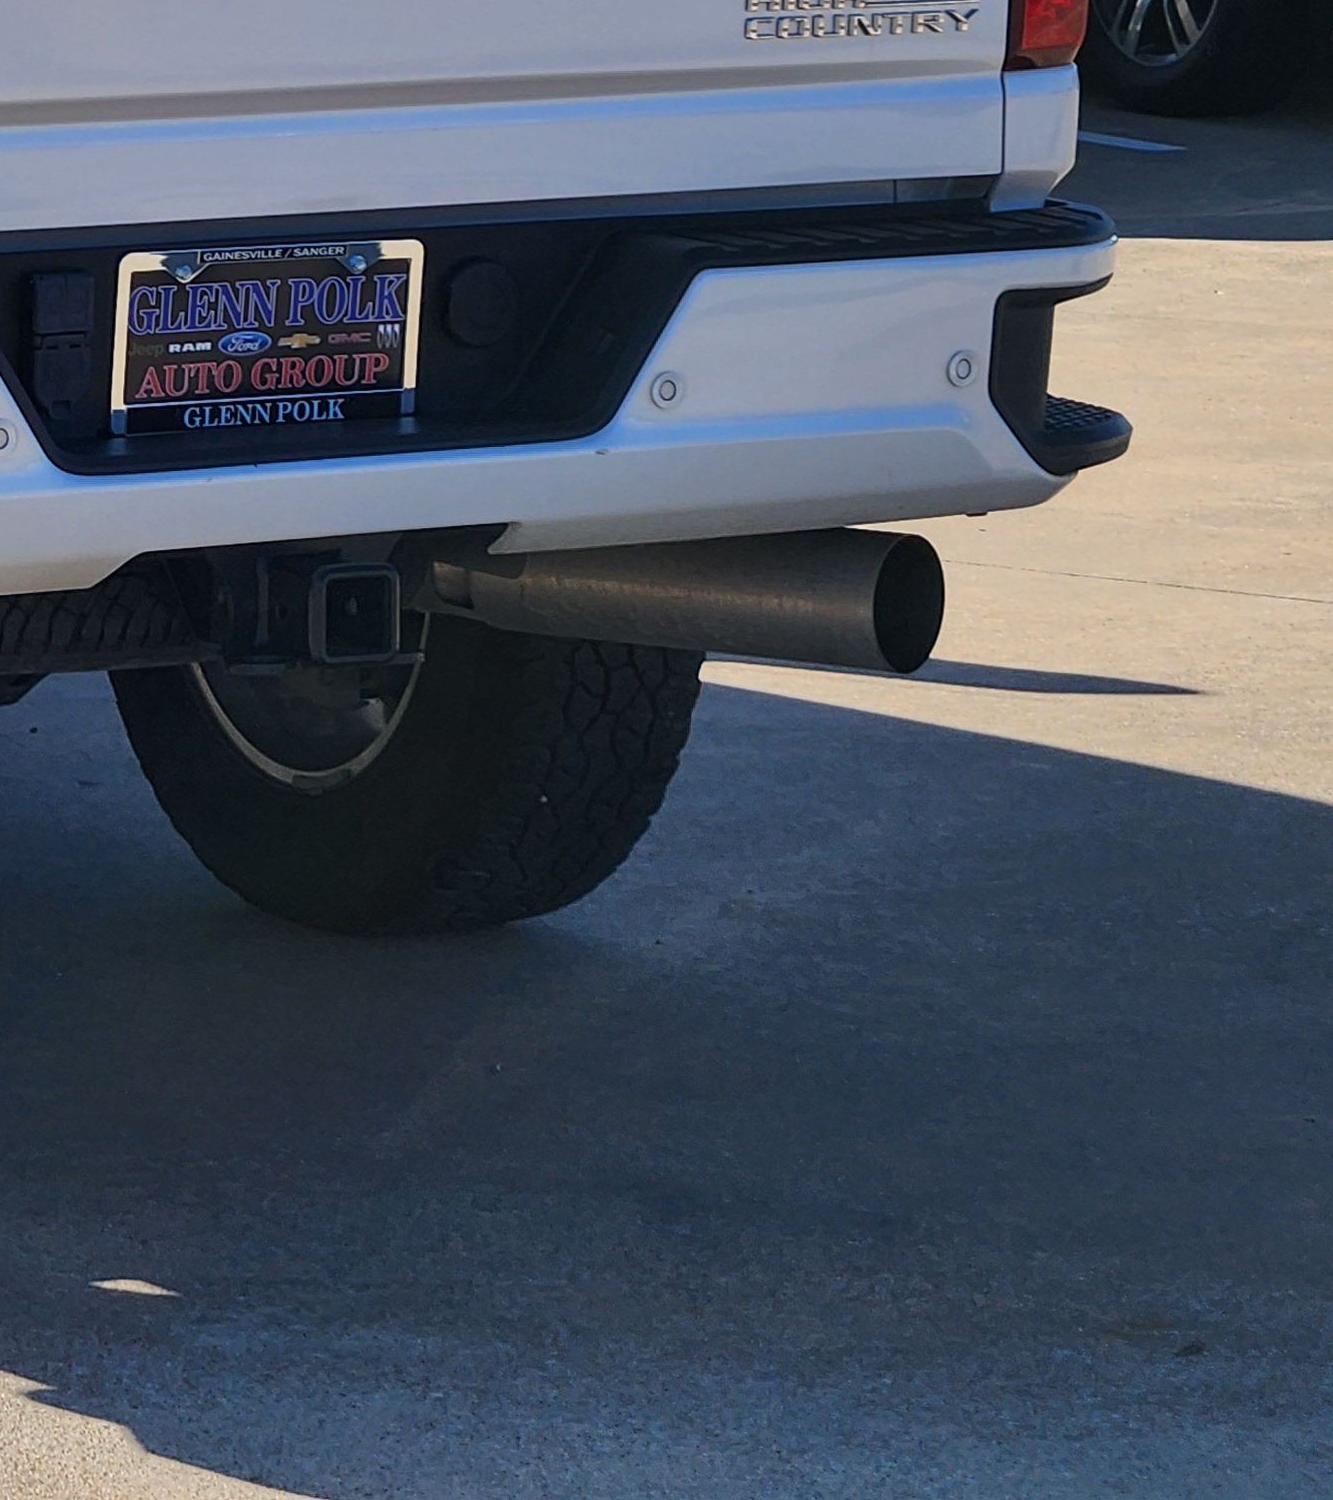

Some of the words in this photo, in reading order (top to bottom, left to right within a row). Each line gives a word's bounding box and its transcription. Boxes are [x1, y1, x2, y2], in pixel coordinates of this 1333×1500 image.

[744, 8, 980, 41] COUNTRY
[202, 248, 283, 263] GAINESVILLE
[293, 245, 345, 258] SANGER
[128, 278, 281, 336] GLENN
[285, 273, 407, 327] POLK
[168, 341, 212, 355] RAM
[328, 332, 372, 344] GMC
[135, 359, 242, 399] AUTO
[250, 352, 390, 390] GROUP
[183, 402, 278, 429] GLENN
[277, 398, 345, 423] POLK
